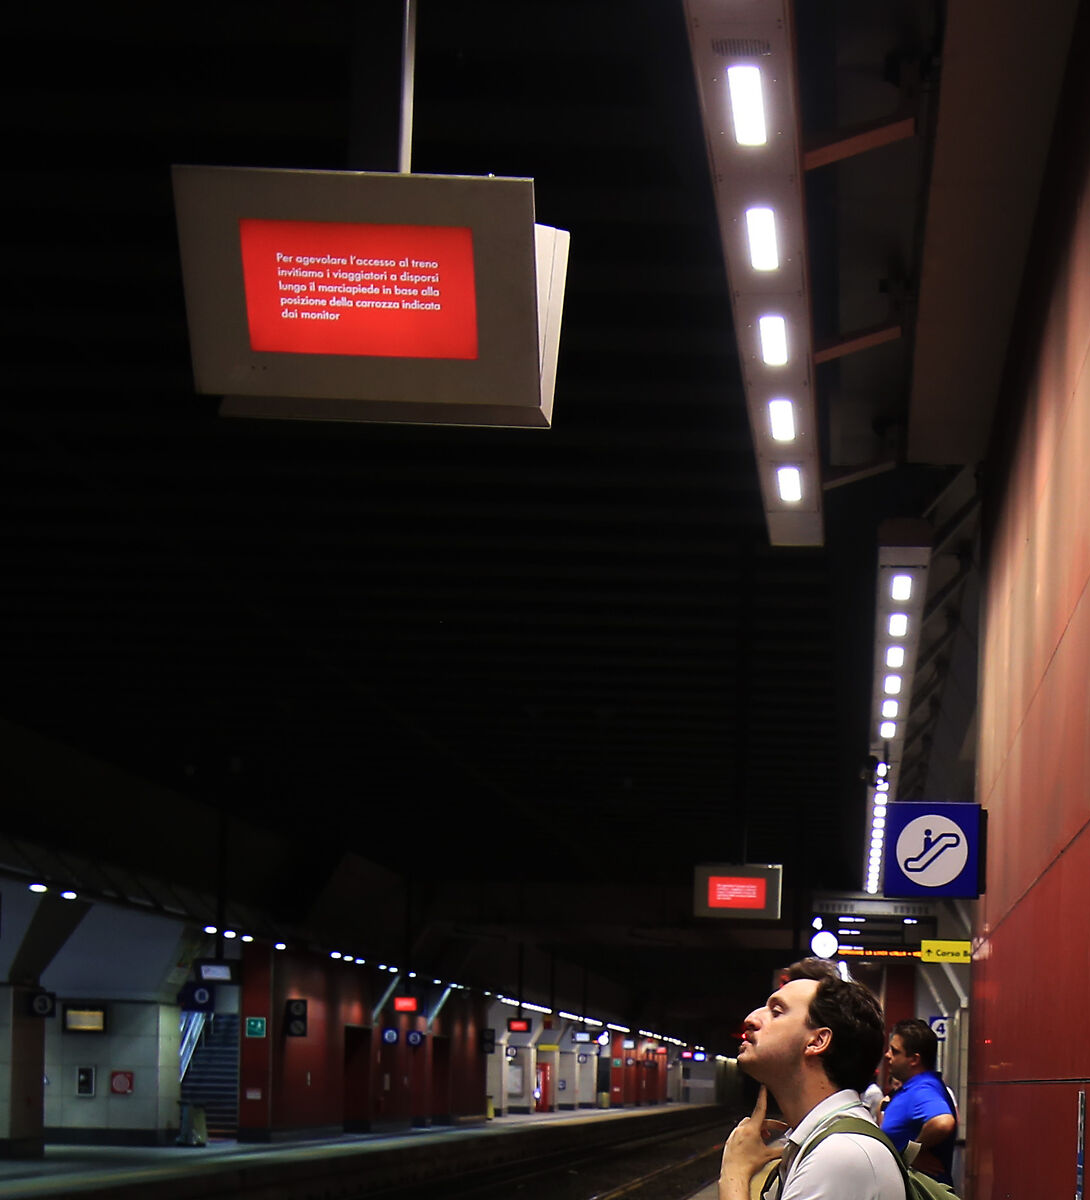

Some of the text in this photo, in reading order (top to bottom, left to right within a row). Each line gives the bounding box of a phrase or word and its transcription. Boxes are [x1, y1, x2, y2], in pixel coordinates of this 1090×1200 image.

[276, 252, 293, 263] Per
[295, 254, 347, 266] agevolare
[399, 257, 409, 267] al
[411, 259, 438, 268] treno
[277, 266, 324, 278] invitiamo
[326, 268, 330, 278] i
[332, 269, 387, 281] viaggiatori
[400, 271, 439, 284] disporsi
[279, 280, 440, 296] lungo il marciapiede in base alla
[280, 295, 441, 310] posizione della carrozza indicata
[281, 308, 340, 320] dai monitor
[936, 949, 960, 957] Corso
[936, 1022, 946, 1035] 4
